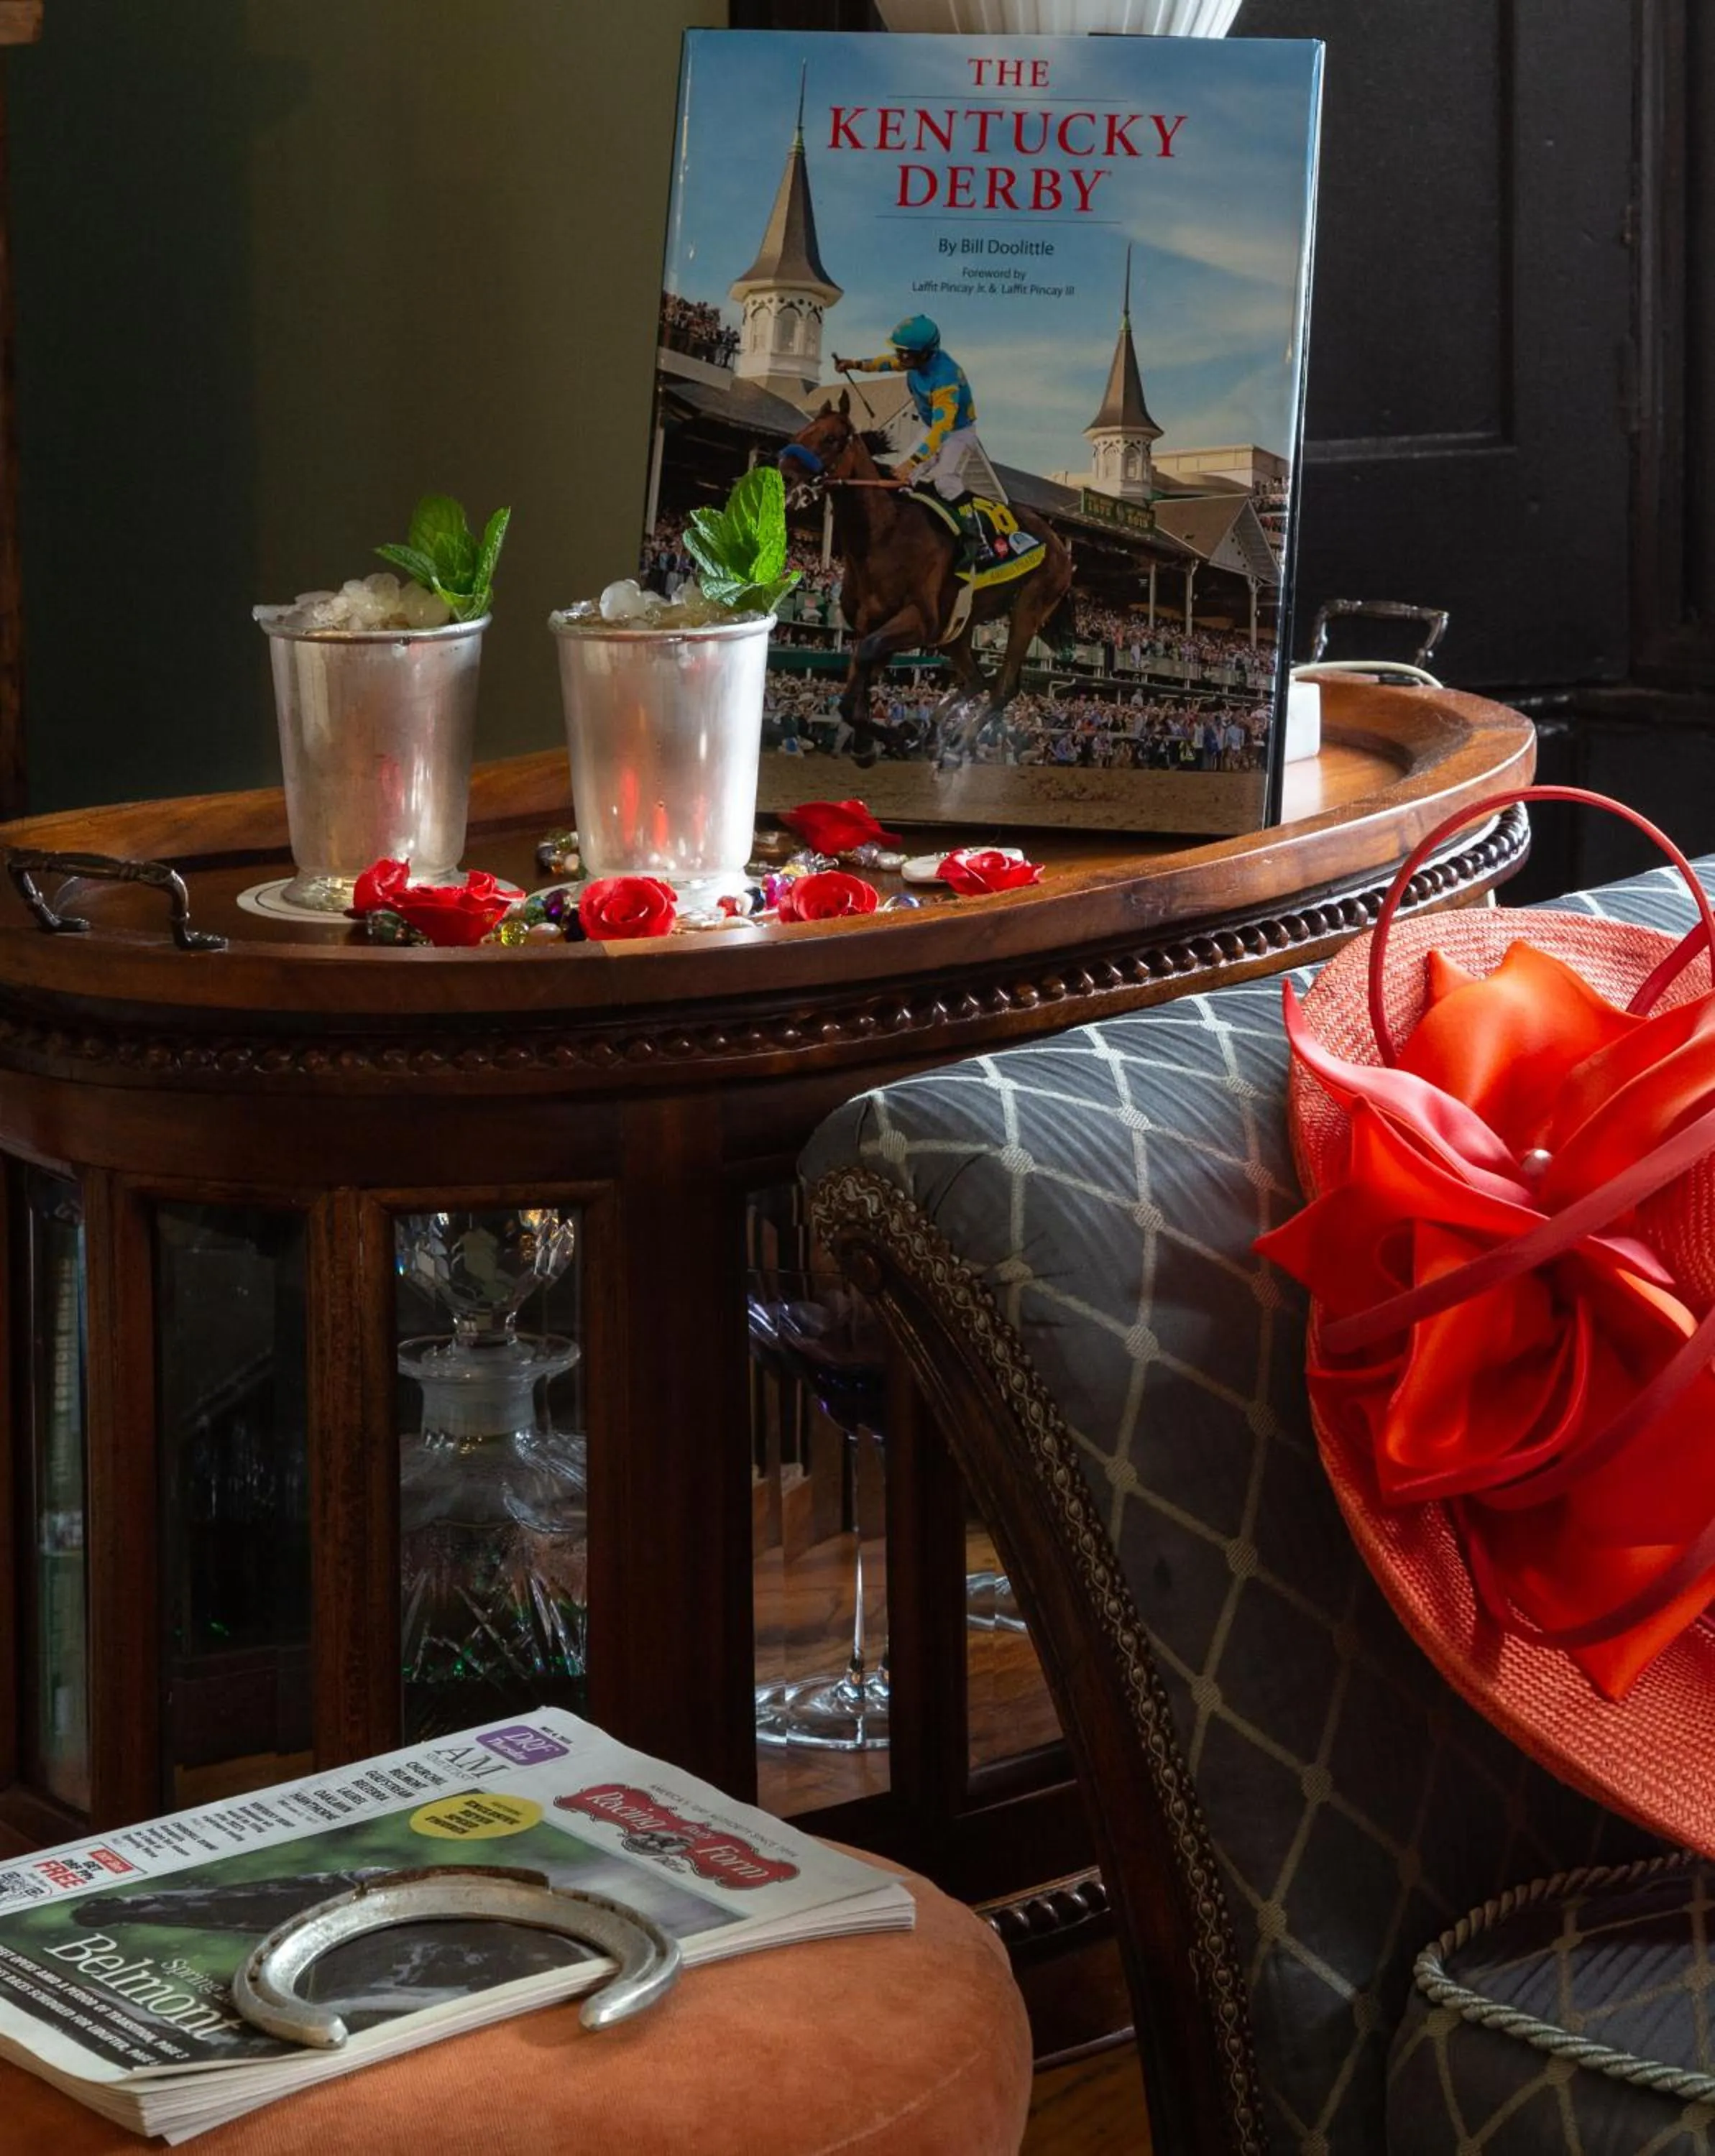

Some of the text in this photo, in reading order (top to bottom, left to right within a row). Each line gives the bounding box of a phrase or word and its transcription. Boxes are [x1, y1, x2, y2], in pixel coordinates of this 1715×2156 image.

[968, 58, 1049, 88] THE
[827, 106, 1188, 157] KENTUCKY
[896, 164, 1106, 212] DERBY
[938, 238, 1054, 257] By Bill Doolittle
[962, 267, 1027, 281] Foreword by
[911, 281, 939, 292] Laffit
[939, 282, 973, 295] Pincay
[988, 284, 997, 294] &
[1001, 283, 1028, 295] Laffit
[1029, 285, 1062, 298] Pincay
[1065, 286, 1075, 295] III
[487, 1737, 530, 1761] Thursday
[502, 1731, 561, 1753] DRF
[433, 1746, 511, 1779] AM
[351, 1779, 390, 1802] BELTERRA
[365, 1770, 415, 1798] GULFSTREAM
[389, 1768, 428, 1789] BELMONT
[290, 1791, 341, 1821] HAWTHORNE
[313, 1789, 354, 1813] OAKLAWN
[336, 1787, 368, 1805] LAUREL
[444, 1812, 479, 1829] SPEED
[464, 1799, 520, 1825] EXCLUSIVE
[585, 1791, 769, 1879] Racing Form
[32, 1859, 88, 1889] FREE
[42, 1932, 242, 2042] Belmont
[160, 1958, 224, 1995] Spring
[2, 1975, 35, 1991] RACES
[70, 2014, 93, 2028] FOR
[126, 2049, 157, 2063] PAGE
[63, 1986, 99, 2007] PERIOD
[93, 2004, 112, 2013] OF
[153, 2040, 183, 2055] PAGE
